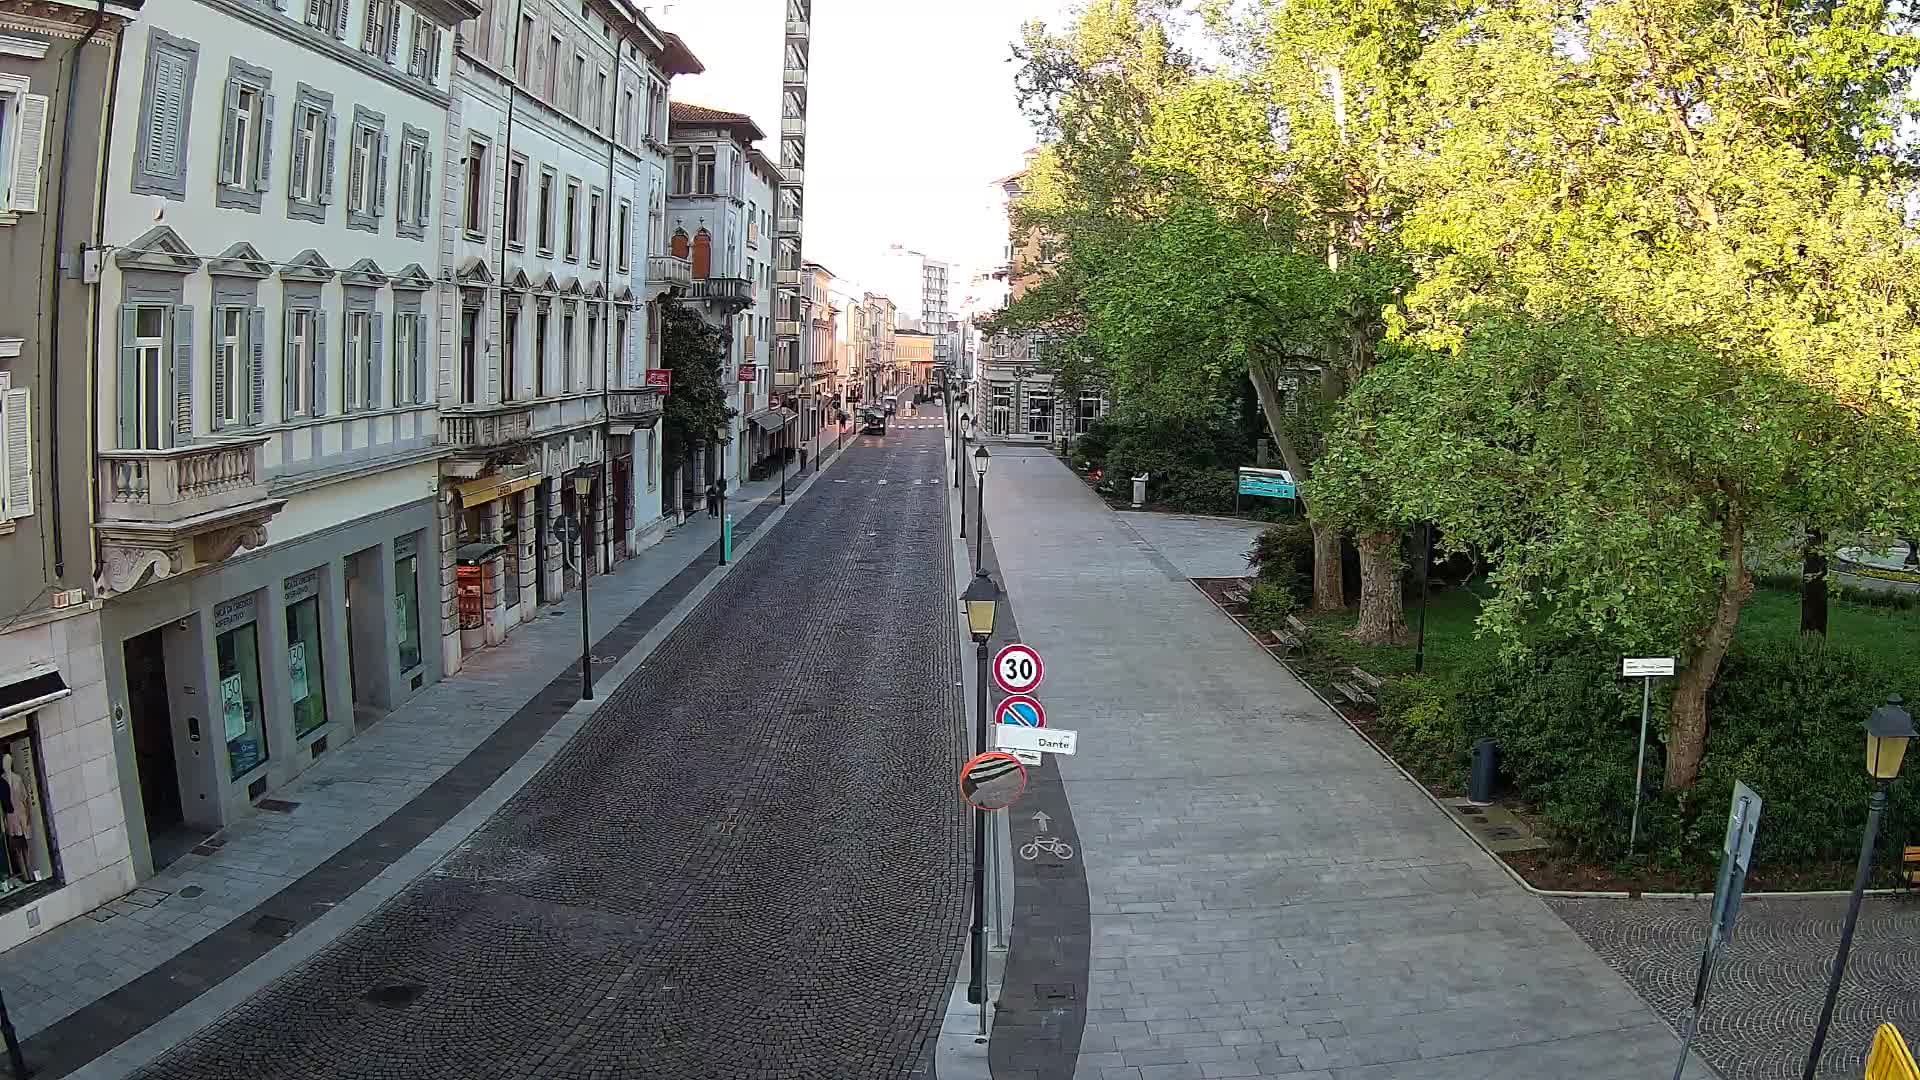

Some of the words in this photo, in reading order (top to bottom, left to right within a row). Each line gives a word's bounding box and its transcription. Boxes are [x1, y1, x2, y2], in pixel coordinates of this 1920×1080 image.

[1006, 658, 1032, 680] 30
[222, 677, 240, 701] 130
[1038, 738, 1069, 749] Dante
